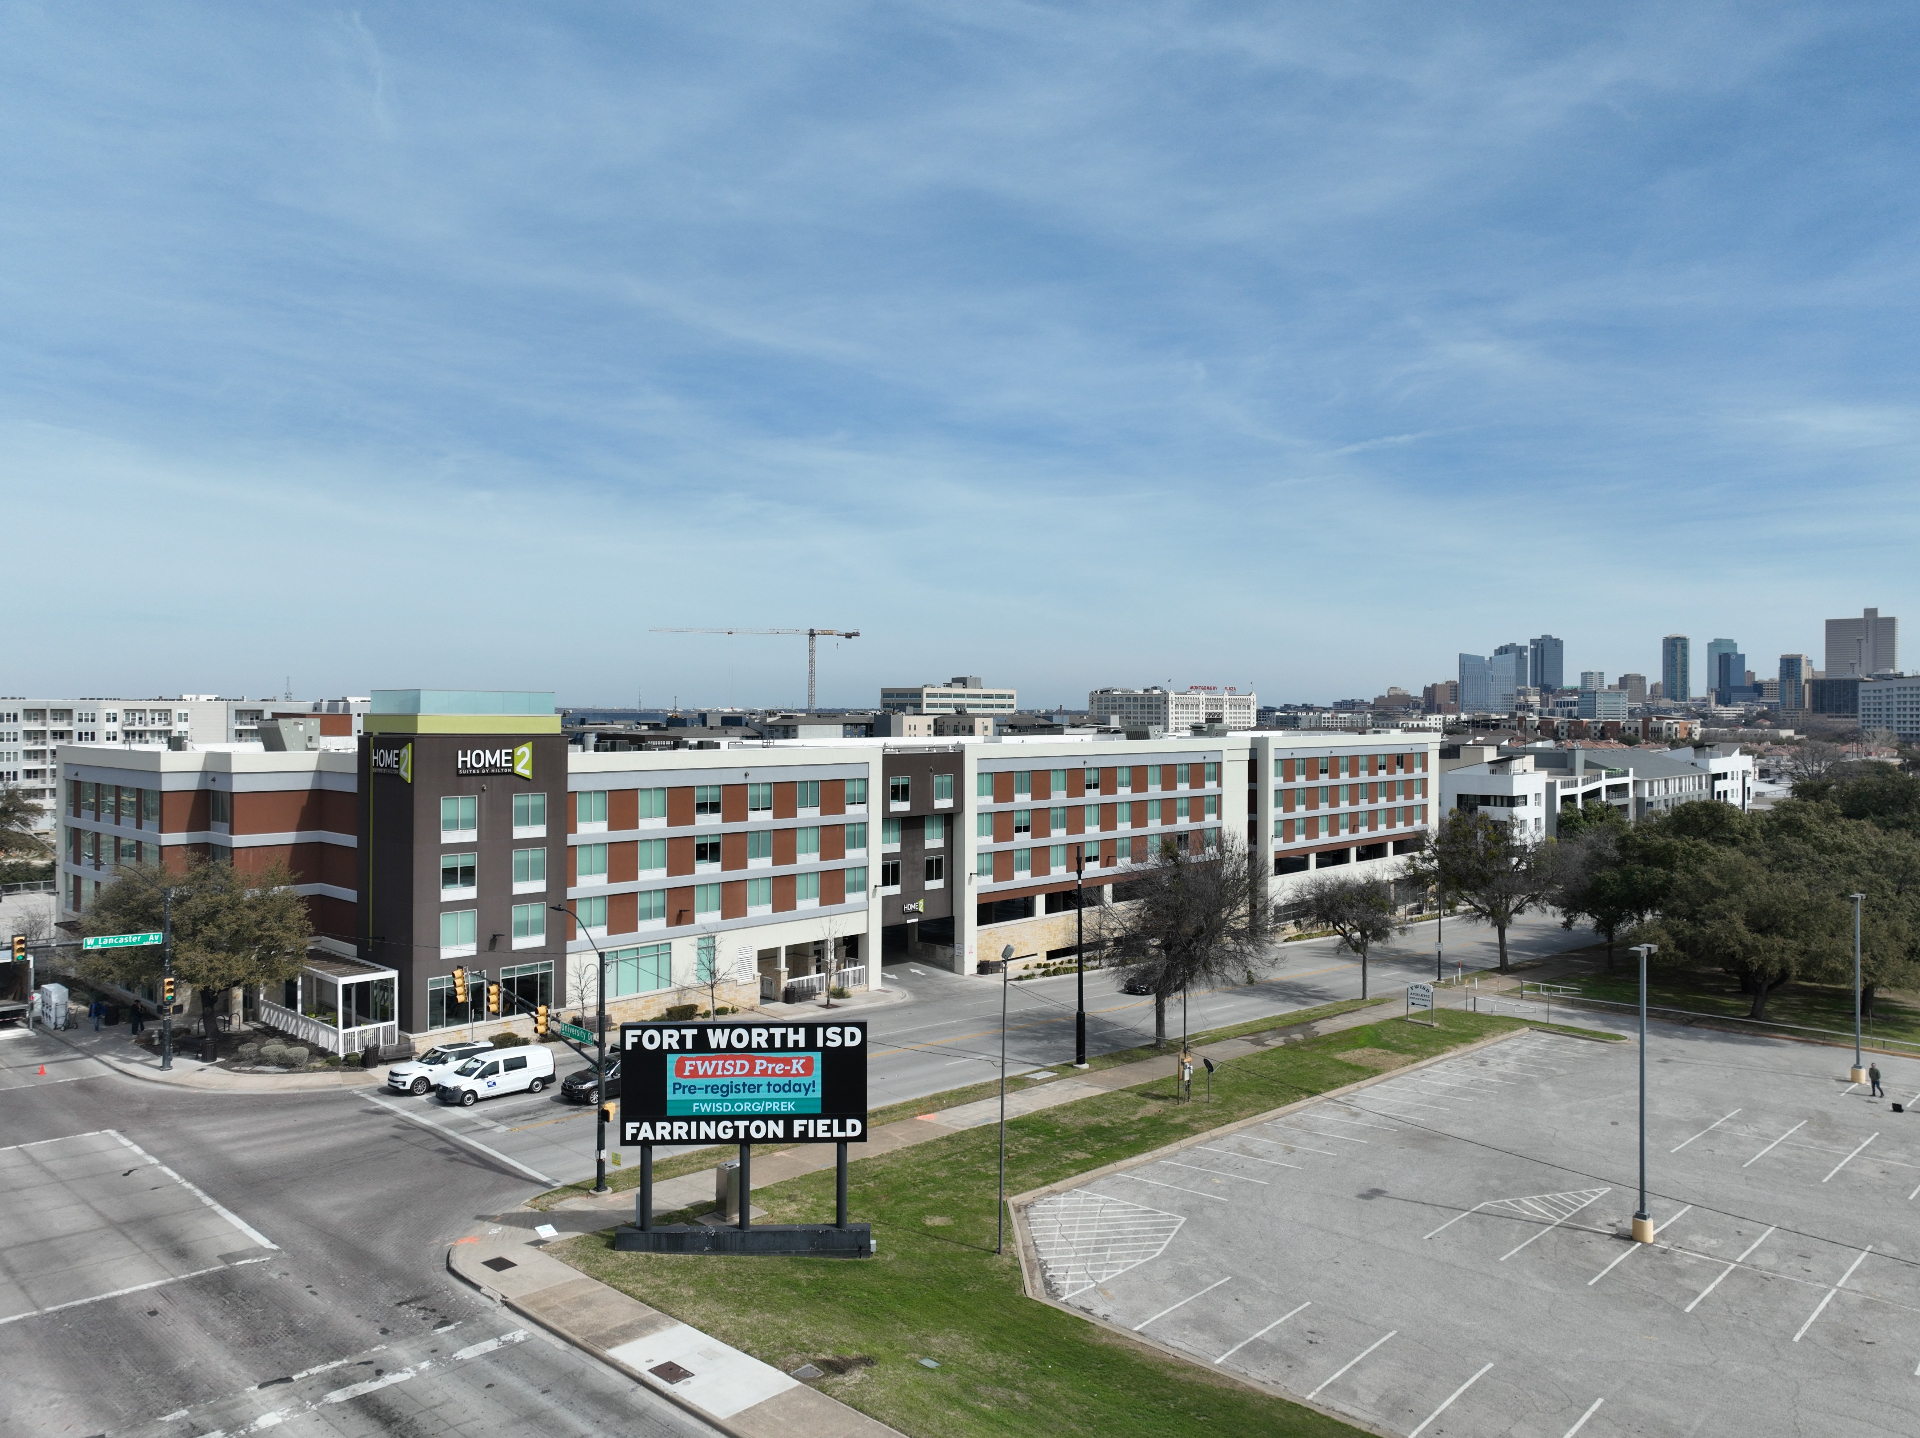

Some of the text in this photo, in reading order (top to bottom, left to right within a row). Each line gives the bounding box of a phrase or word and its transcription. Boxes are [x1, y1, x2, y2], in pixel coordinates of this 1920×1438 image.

[373, 748, 408, 779] HOME 2
[458, 746, 530, 776] HOME 2
[904, 901, 924, 912] HOME 2
[98, 936, 141, 945] Lancaster
[562, 1024, 593, 1041] University Dr
[625, 1026, 862, 1050] FORT WORTH ISD
[683, 1058, 806, 1076] FWISD Pre-K
[672, 1080, 816, 1098] Pre-register today!
[692, 1102, 796, 1113] FWISD.ORG/PREK
[625, 1118, 862, 1141] FARRINGTON FIELD
